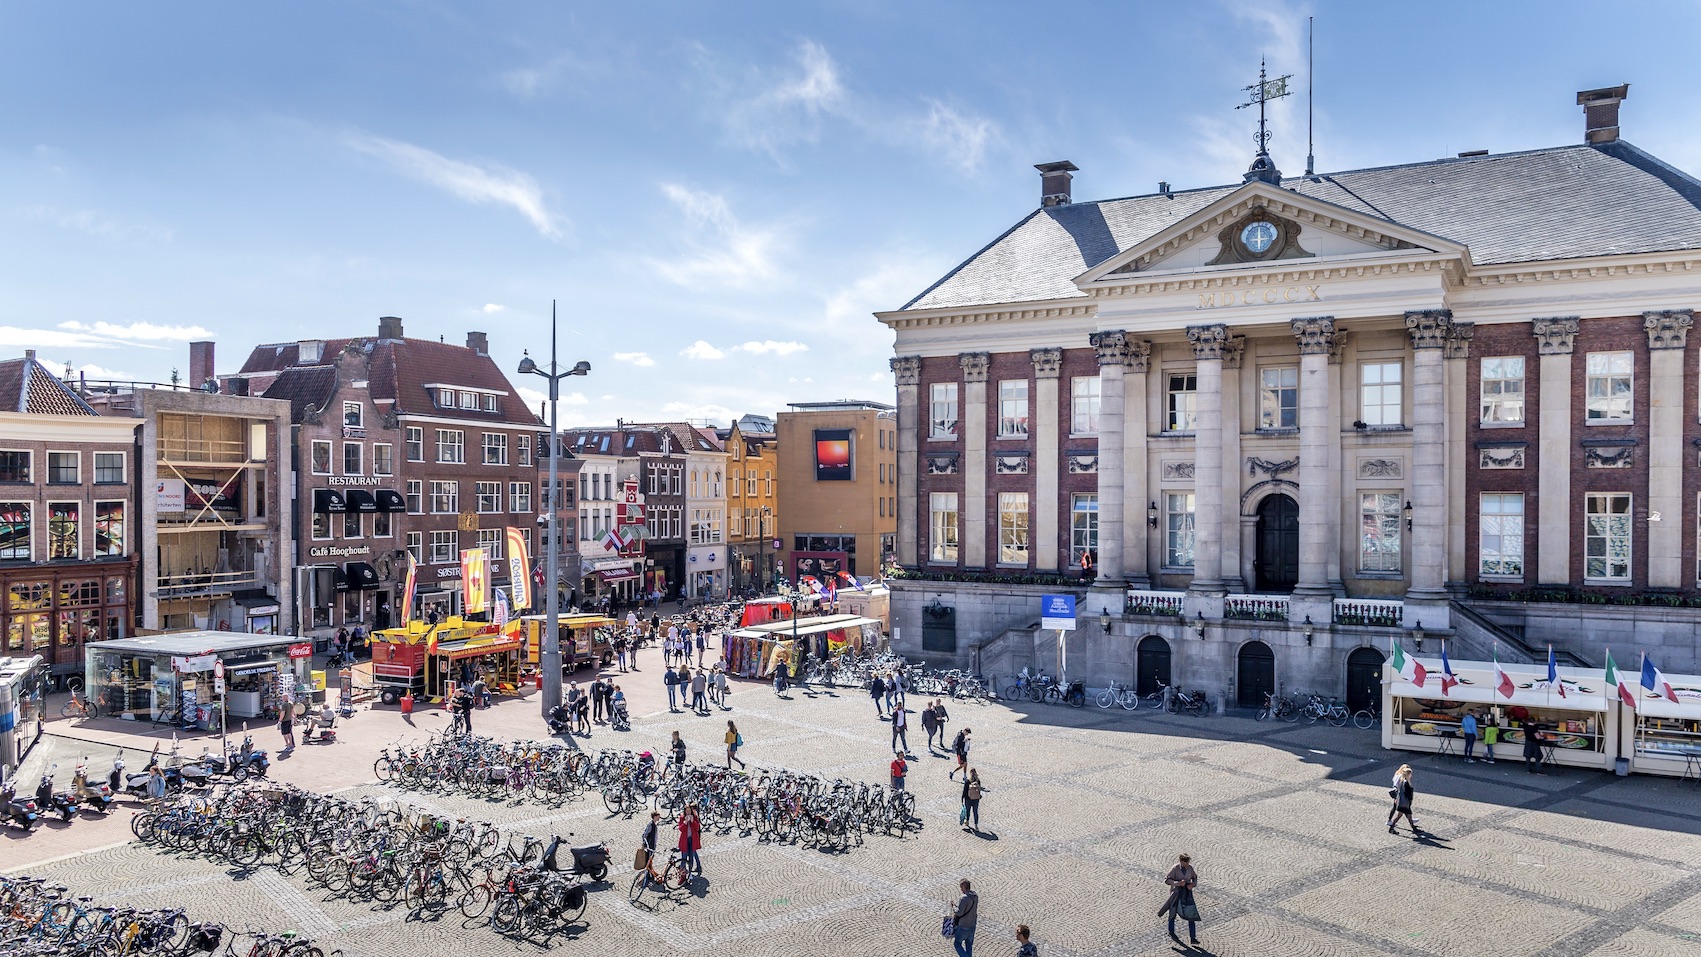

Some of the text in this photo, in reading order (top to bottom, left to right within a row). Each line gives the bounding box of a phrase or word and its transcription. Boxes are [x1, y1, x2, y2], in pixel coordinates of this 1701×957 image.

[1198, 285, 1320, 308] MDCCCX
[328, 476, 382, 485] RESTAURANT
[310, 546, 370, 557] Café Hooghoudt
[437, 566, 462, 577] SØSTR
[290, 645, 312, 657] Coca-Cola
